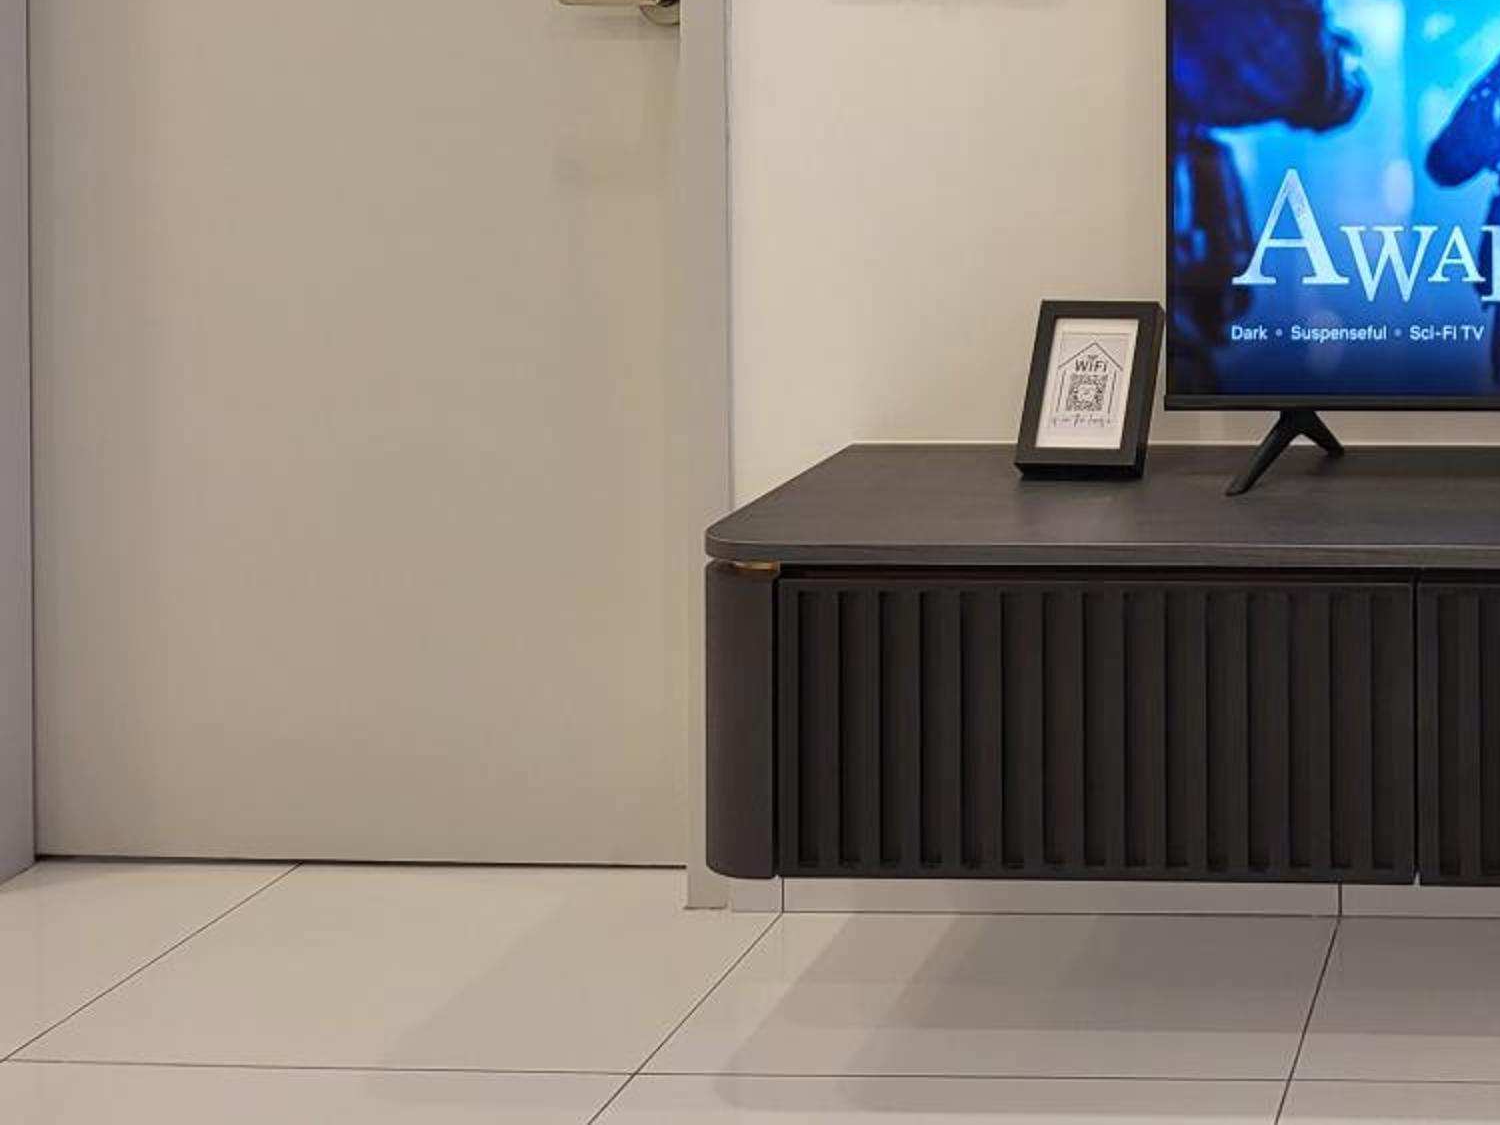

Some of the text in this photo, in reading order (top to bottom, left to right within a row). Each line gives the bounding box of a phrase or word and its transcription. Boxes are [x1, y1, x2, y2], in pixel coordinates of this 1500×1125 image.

[1231, 325, 1485, 343] Dark Suspenseful Sci-Fi TV
